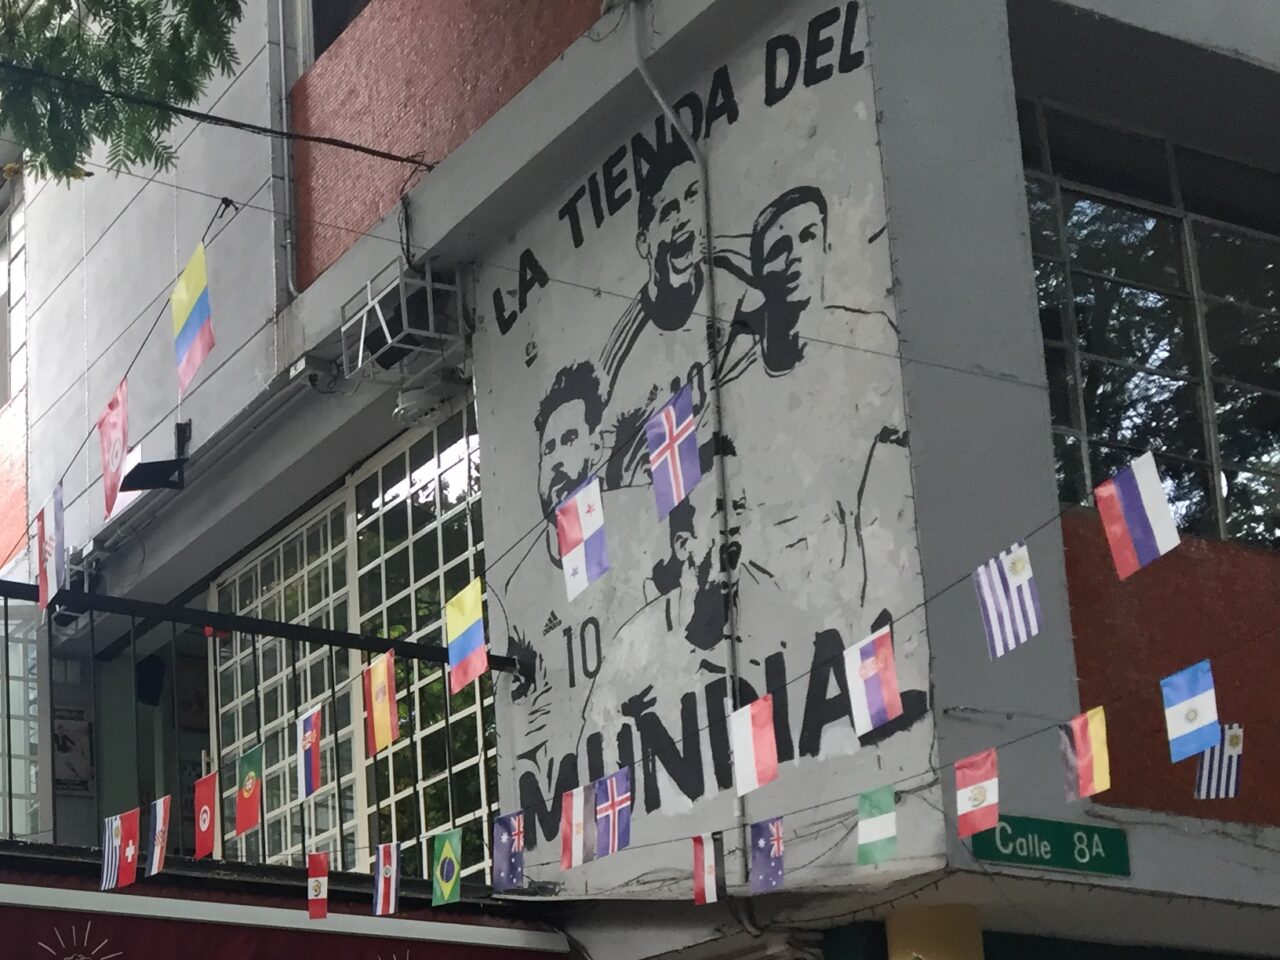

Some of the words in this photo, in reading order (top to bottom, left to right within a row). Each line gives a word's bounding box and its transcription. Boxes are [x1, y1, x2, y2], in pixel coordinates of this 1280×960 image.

[492, 248, 550, 336] LA
[558, 64, 739, 249] TIENDA
[764, 0, 866, 108] DEL
[562, 615, 603, 688] 10
[995, 821, 1052, 860] Calle
[1073, 831, 1106, 864] 8A
